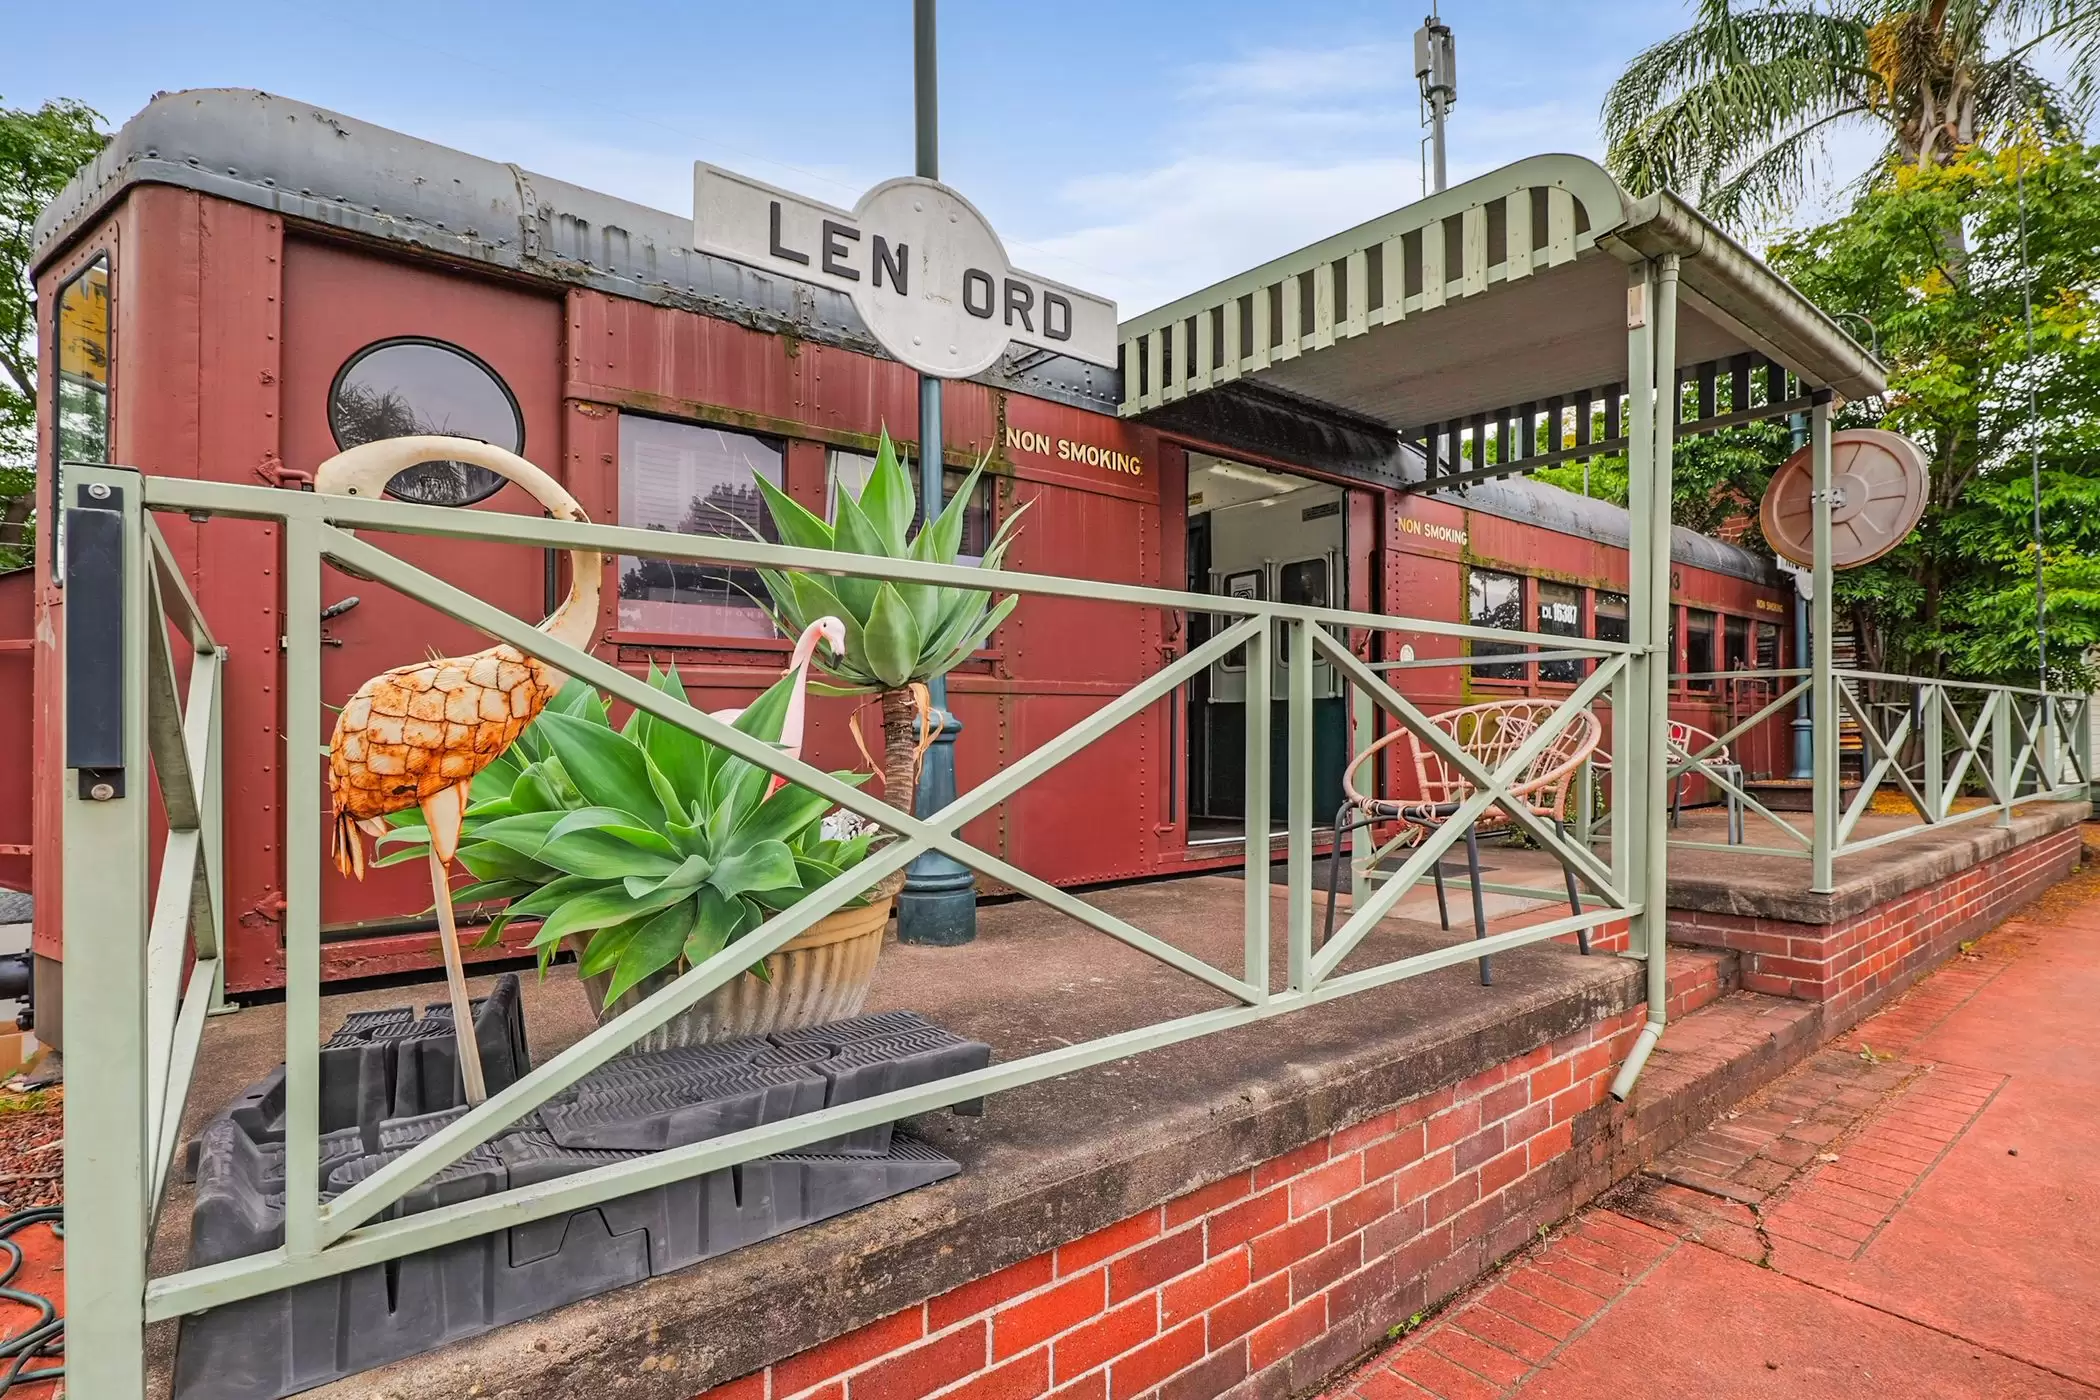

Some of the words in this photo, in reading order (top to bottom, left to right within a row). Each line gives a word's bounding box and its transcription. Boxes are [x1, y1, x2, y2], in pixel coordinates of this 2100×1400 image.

[1006, 426, 1050, 456] NON
[1057, 439, 1141, 476] SMOKING
[1398, 517, 1421, 535] NON
[1424, 523, 1467, 545] SMOKING
[1541, 605, 1552, 619] DL
